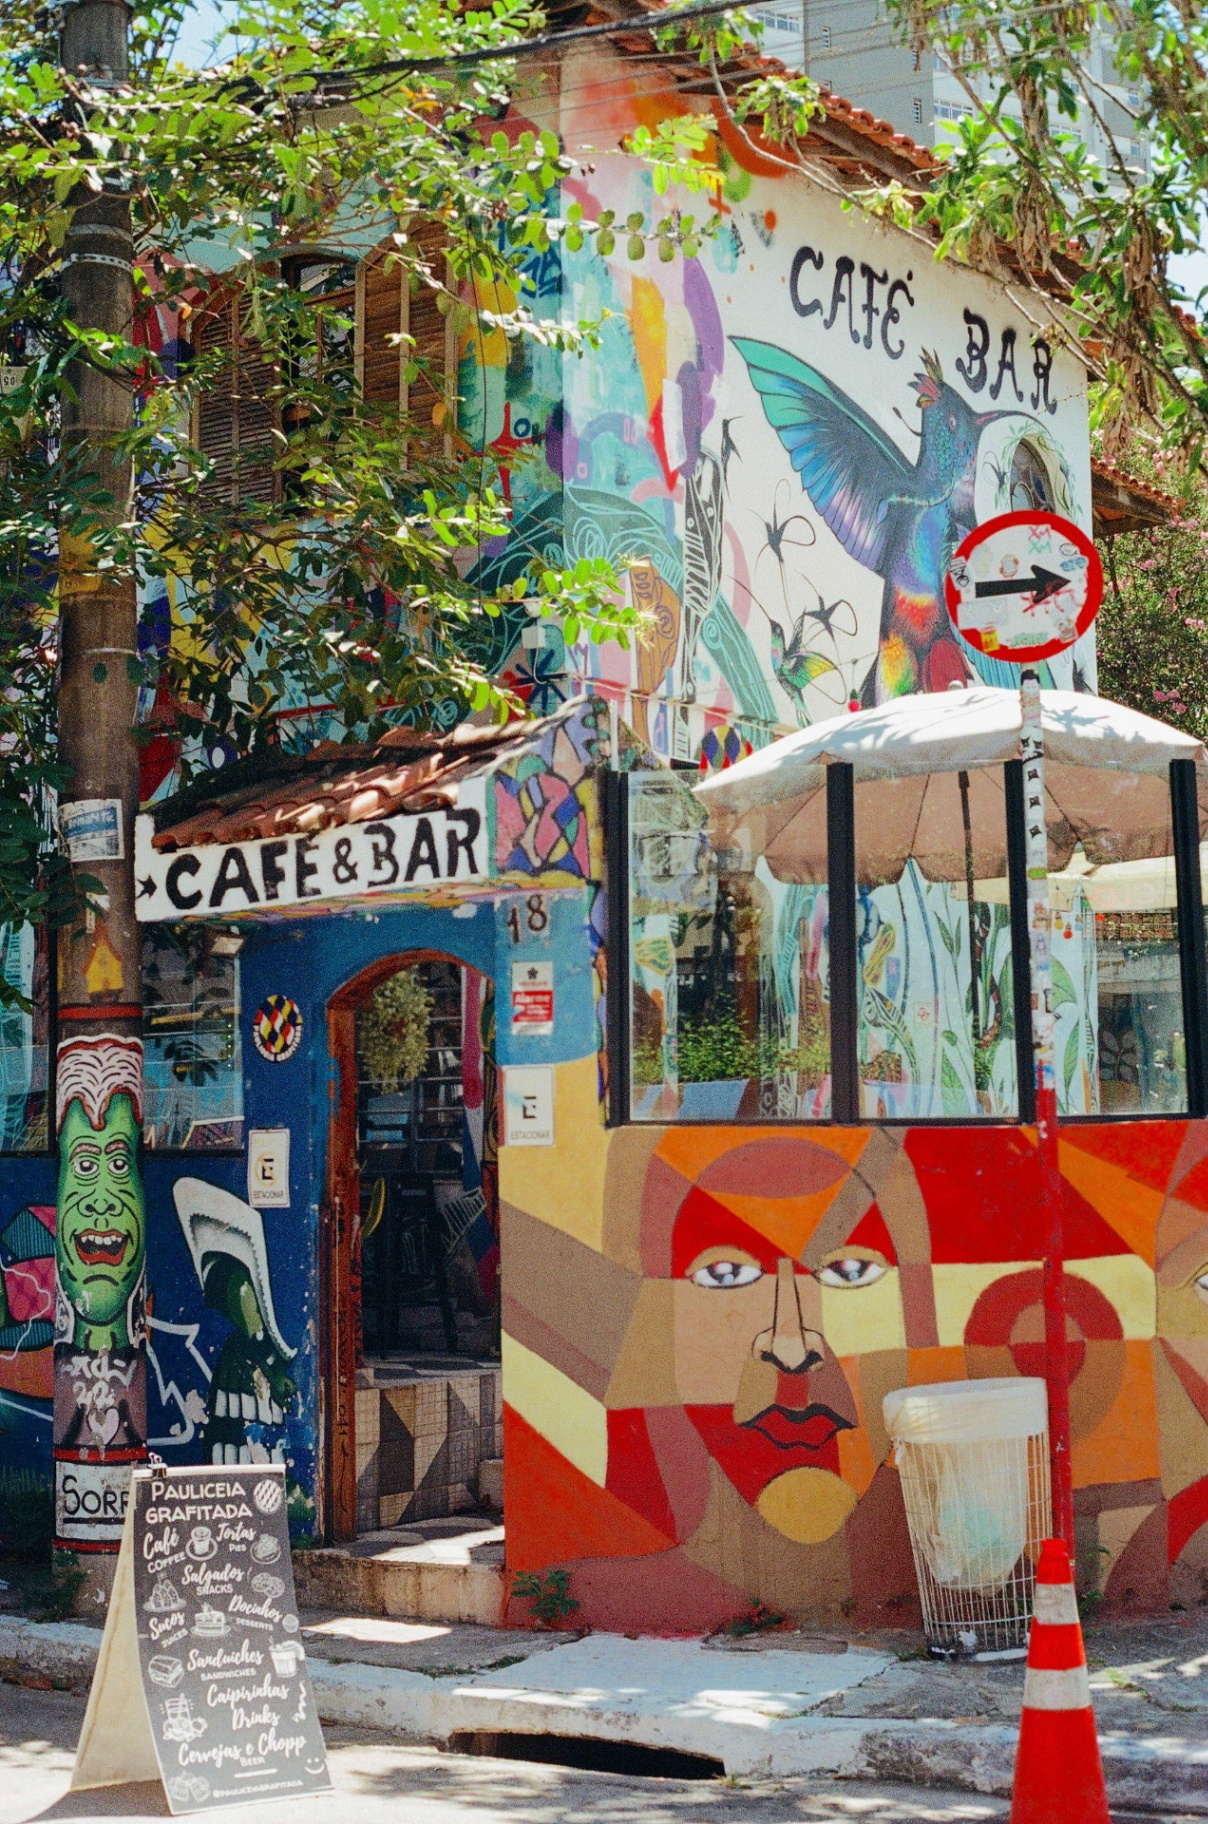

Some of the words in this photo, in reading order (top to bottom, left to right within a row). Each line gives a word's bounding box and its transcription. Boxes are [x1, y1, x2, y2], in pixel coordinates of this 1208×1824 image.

[955, 306, 1058, 415] BAR
[363, 806, 479, 888] BAR
[507, 894, 548, 943] 18
[151, 1481, 246, 1502] PAULICEIA
[145, 1503, 253, 1524] GRAFITADA
[143, 1526, 179, 1560] Café
[216, 1521, 256, 1542] Tortas
[147, 1551, 187, 1574] COFFEE
[181, 1563, 244, 1588] Salgados
[196, 1584, 233, 1596] SNACKS
[228, 1595, 282, 1622] Docinhos
[149, 1612, 185, 1640] Sucos
[235, 1617, 274, 1631] DESSERTS
[161, 1627, 188, 1648] JUICES
[200, 1667, 257, 1681] SANDWICHES
[207, 1672, 290, 1710] Caipirinhas
[232, 1703, 280, 1731] Drinks
[178, 1742, 241, 1768] Cervejas
[245, 1743, 255, 1756] e
[258, 1727, 307, 1758] Chopp
[239, 1756, 265, 1767] BEER
